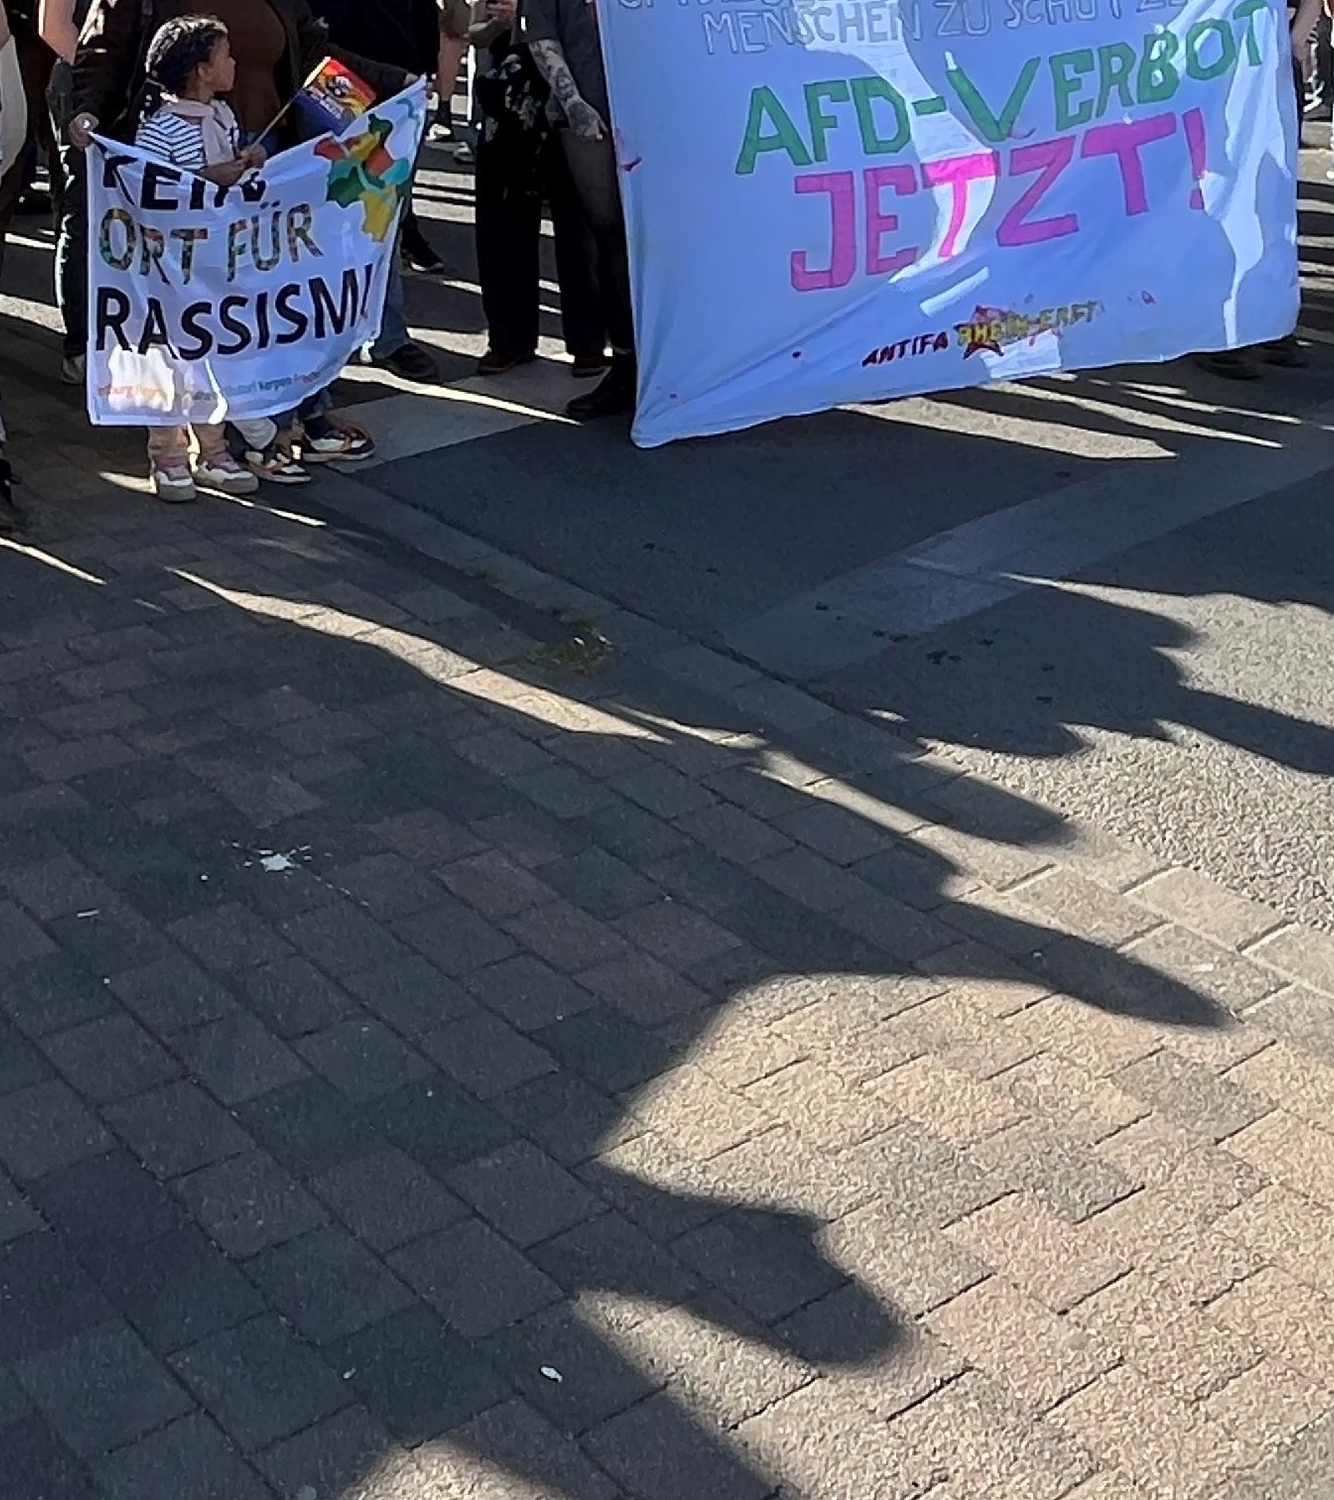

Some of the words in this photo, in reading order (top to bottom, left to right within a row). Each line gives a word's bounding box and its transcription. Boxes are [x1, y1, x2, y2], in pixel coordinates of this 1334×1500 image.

[701, 2, 922, 56] MENSCHEN
[932, 0, 991, 38] ZU
[790, 108, 1207, 293] JETZT!
[99, 207, 209, 285] ORT
[227, 200, 323, 283] FÜR
[861, 331, 949, 367] ANTIFA
